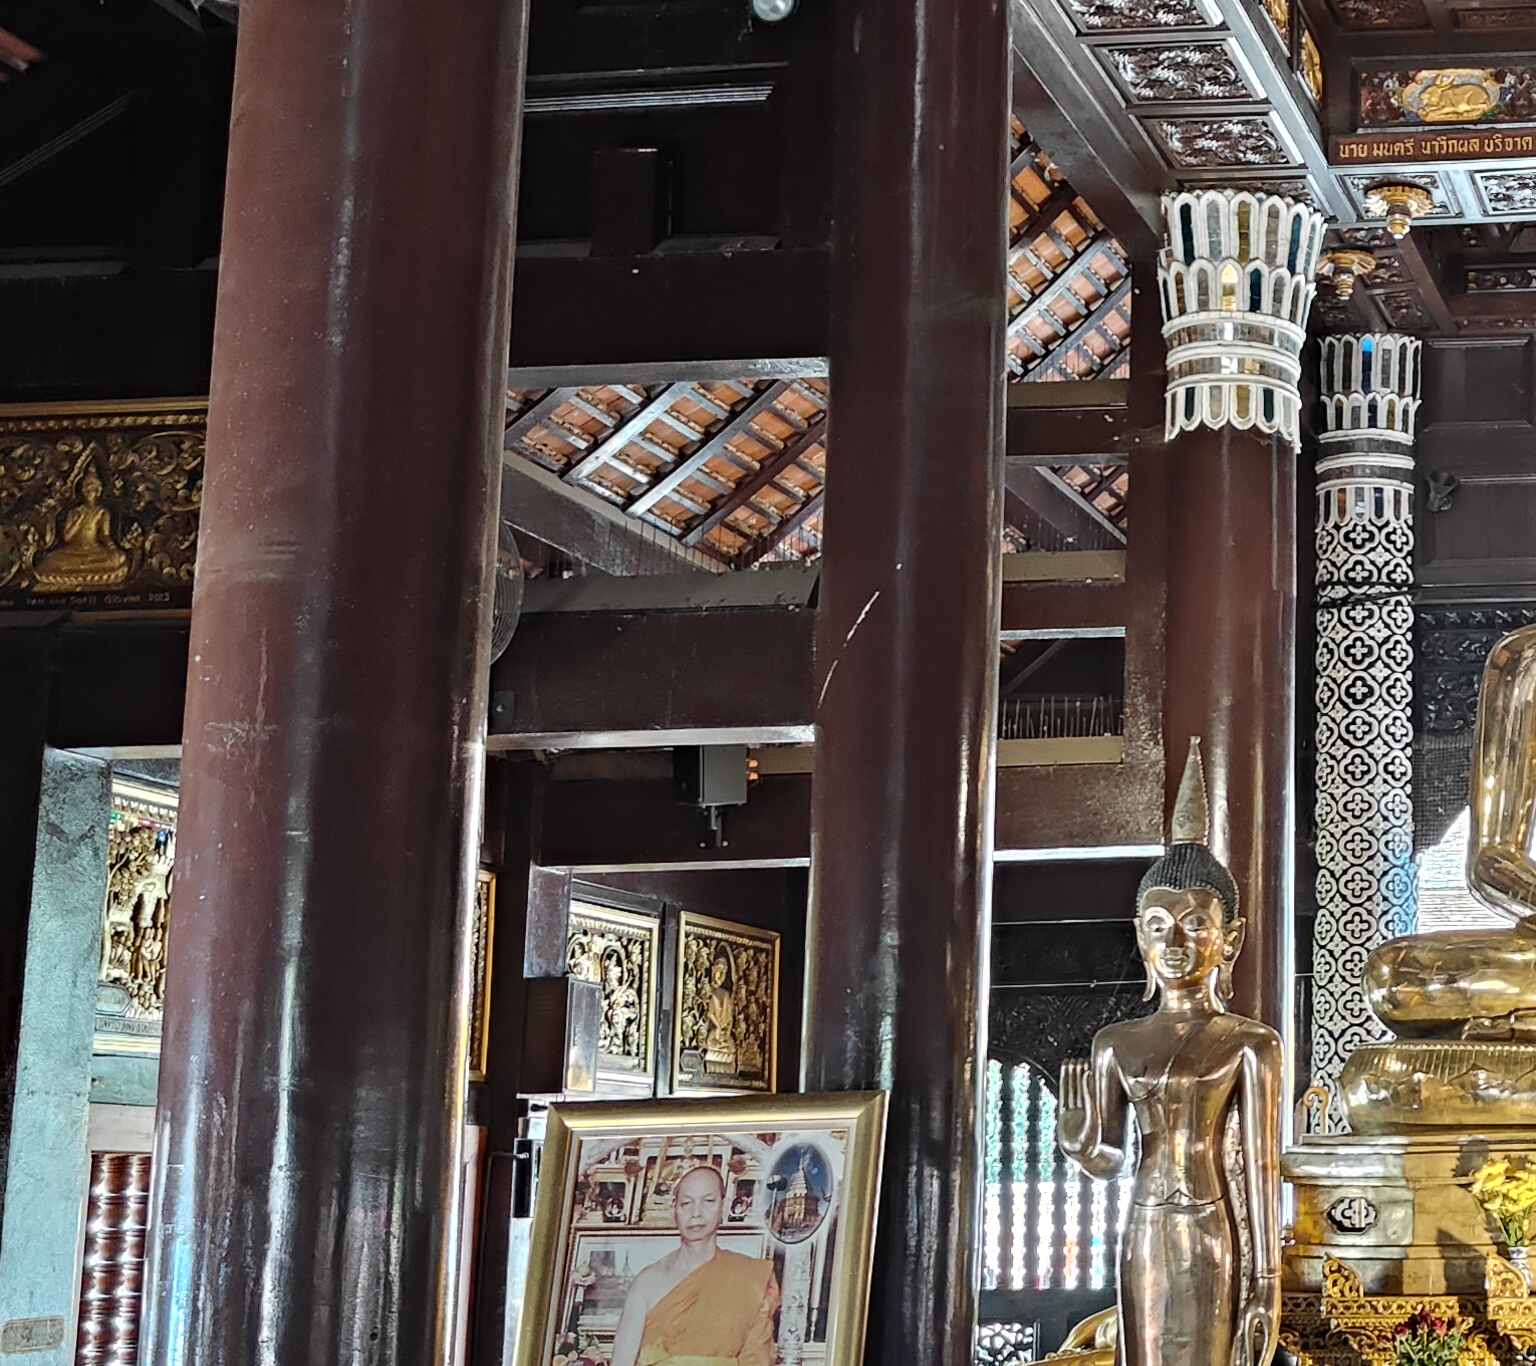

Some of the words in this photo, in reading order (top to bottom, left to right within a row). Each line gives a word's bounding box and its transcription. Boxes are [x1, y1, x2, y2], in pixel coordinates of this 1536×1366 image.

[1339, 141, 1369, 158] นาย
[1372, 137, 1414, 157] มนตรี
[1484, 133, 1534, 153] บริจาค
